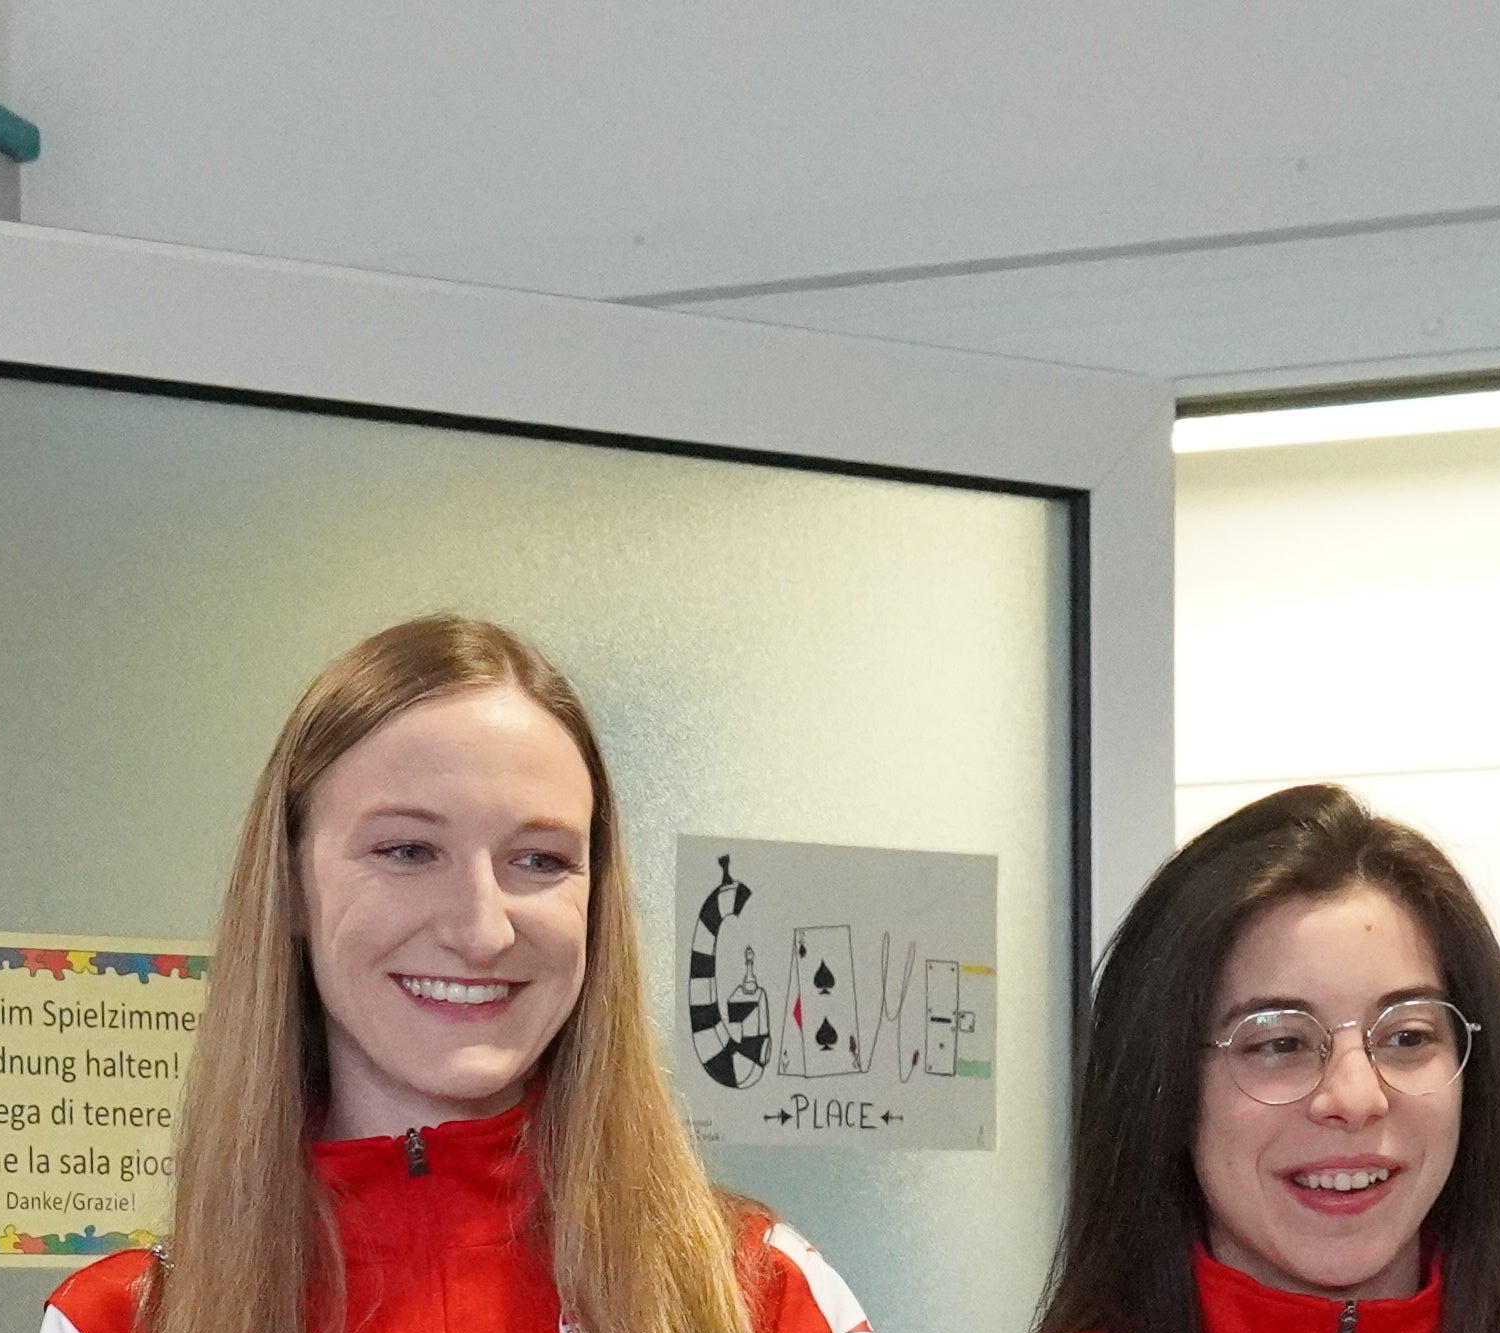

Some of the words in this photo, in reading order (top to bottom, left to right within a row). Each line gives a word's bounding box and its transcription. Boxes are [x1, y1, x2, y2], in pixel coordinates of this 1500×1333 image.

[0, 998, 33, 1026] im
[43, 999, 202, 1034] Spielzimme
[85, 1048, 180, 1079] halten!
[51, 1097, 74, 1126] di
[83, 1100, 172, 1128] tenere
[790, 1093, 878, 1129] PLACE
[28, 1145, 50, 1174] la
[59, 1146, 110, 1175] sala
[119, 1148, 174, 1182] gioc
[6, 1190, 136, 1214] Danke/Grazie!
